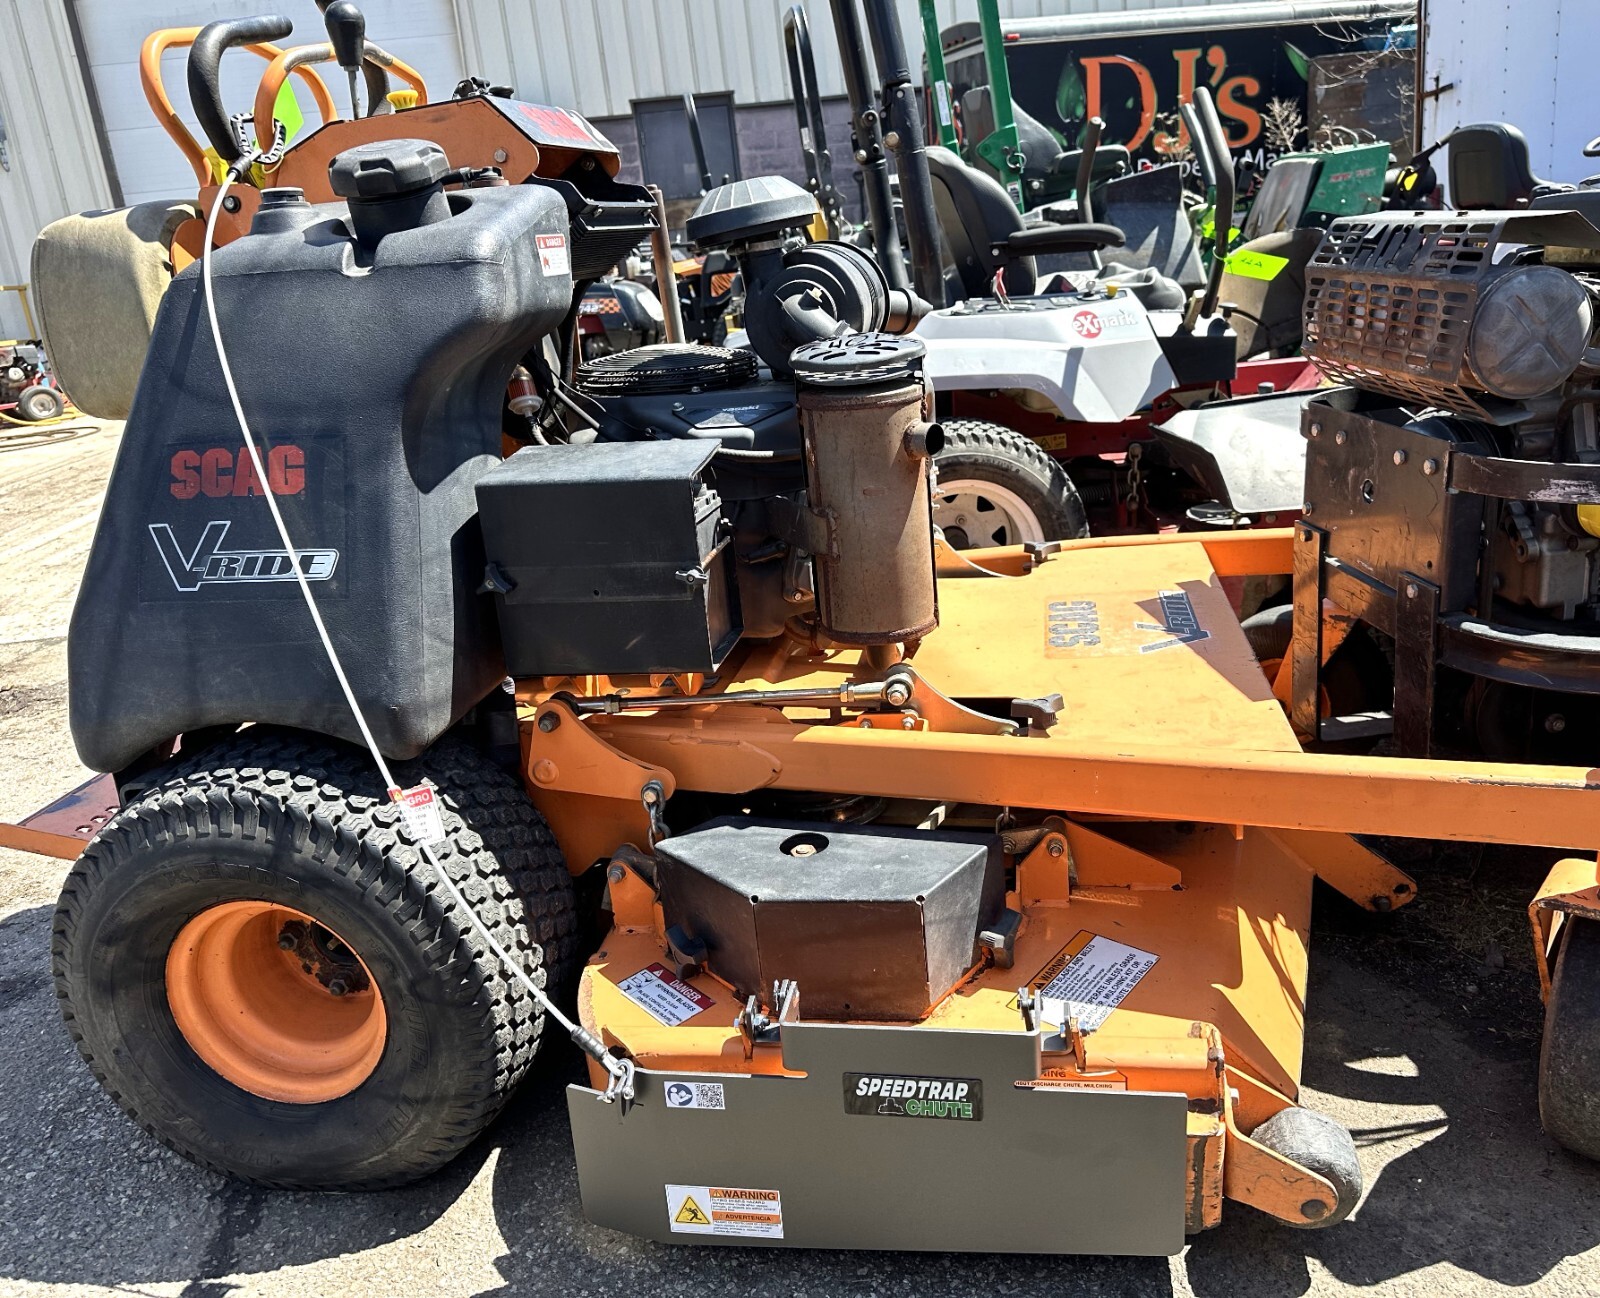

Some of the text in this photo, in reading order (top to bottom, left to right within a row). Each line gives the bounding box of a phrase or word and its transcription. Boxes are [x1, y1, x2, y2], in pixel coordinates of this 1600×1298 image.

[1079, 45, 1262, 153] DJ's
[170, 445, 305, 499] SCAG
[1048, 600, 1101, 647] SCAG
[1055, 965, 1075, 982] BLADES
[1070, 956, 1083, 966] AND
[1079, 943, 1096, 956] BELTS
[1102, 967, 1123, 985] UNLESS
[1118, 952, 1136, 968] GRASS
[1128, 959, 1154, 983] INSTALLED
[668, 979, 702, 1001] DANGER
[1102, 975, 1128, 999] MULCHING
[1123, 967, 1135, 976] KIT
[1130, 960, 1141, 968] OR
[856, 1077, 969, 1101] SPEEDTRAP
[905, 1099, 973, 1118] CHUTE
[721, 1190, 776, 1201] WARNING
[725, 1213, 772, 1222] ADVERTENCIA
